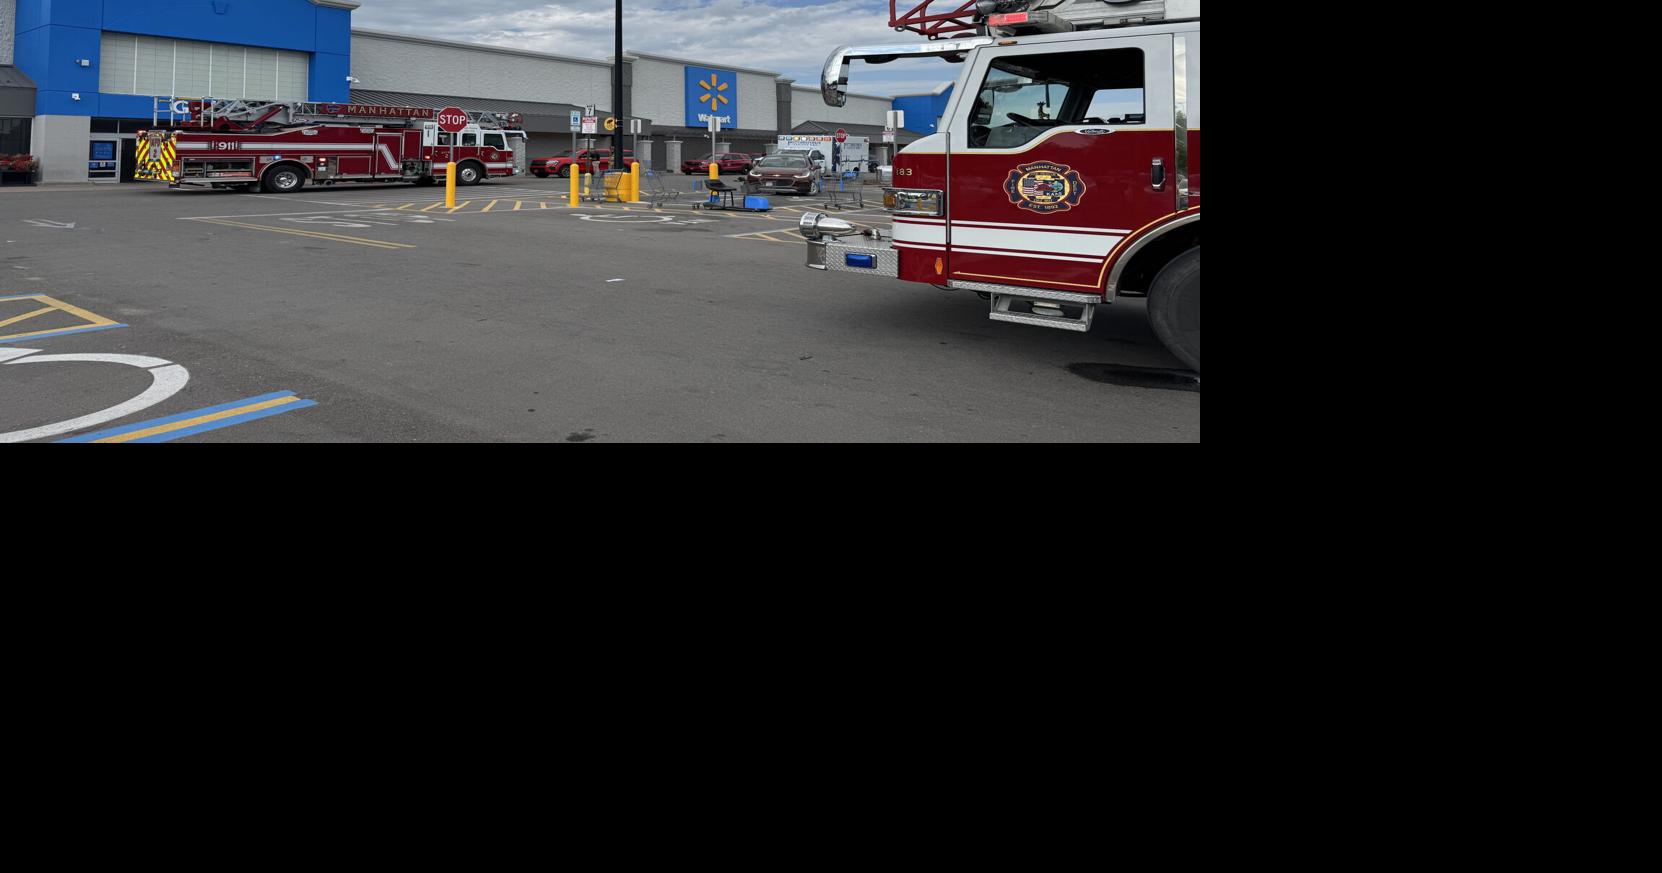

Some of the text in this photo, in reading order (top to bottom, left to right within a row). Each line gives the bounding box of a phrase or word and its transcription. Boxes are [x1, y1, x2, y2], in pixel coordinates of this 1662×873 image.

[347, 105, 429, 117] MANHATTAN
[439, 114, 466, 125] STOP
[697, 113, 731, 124] Waart
